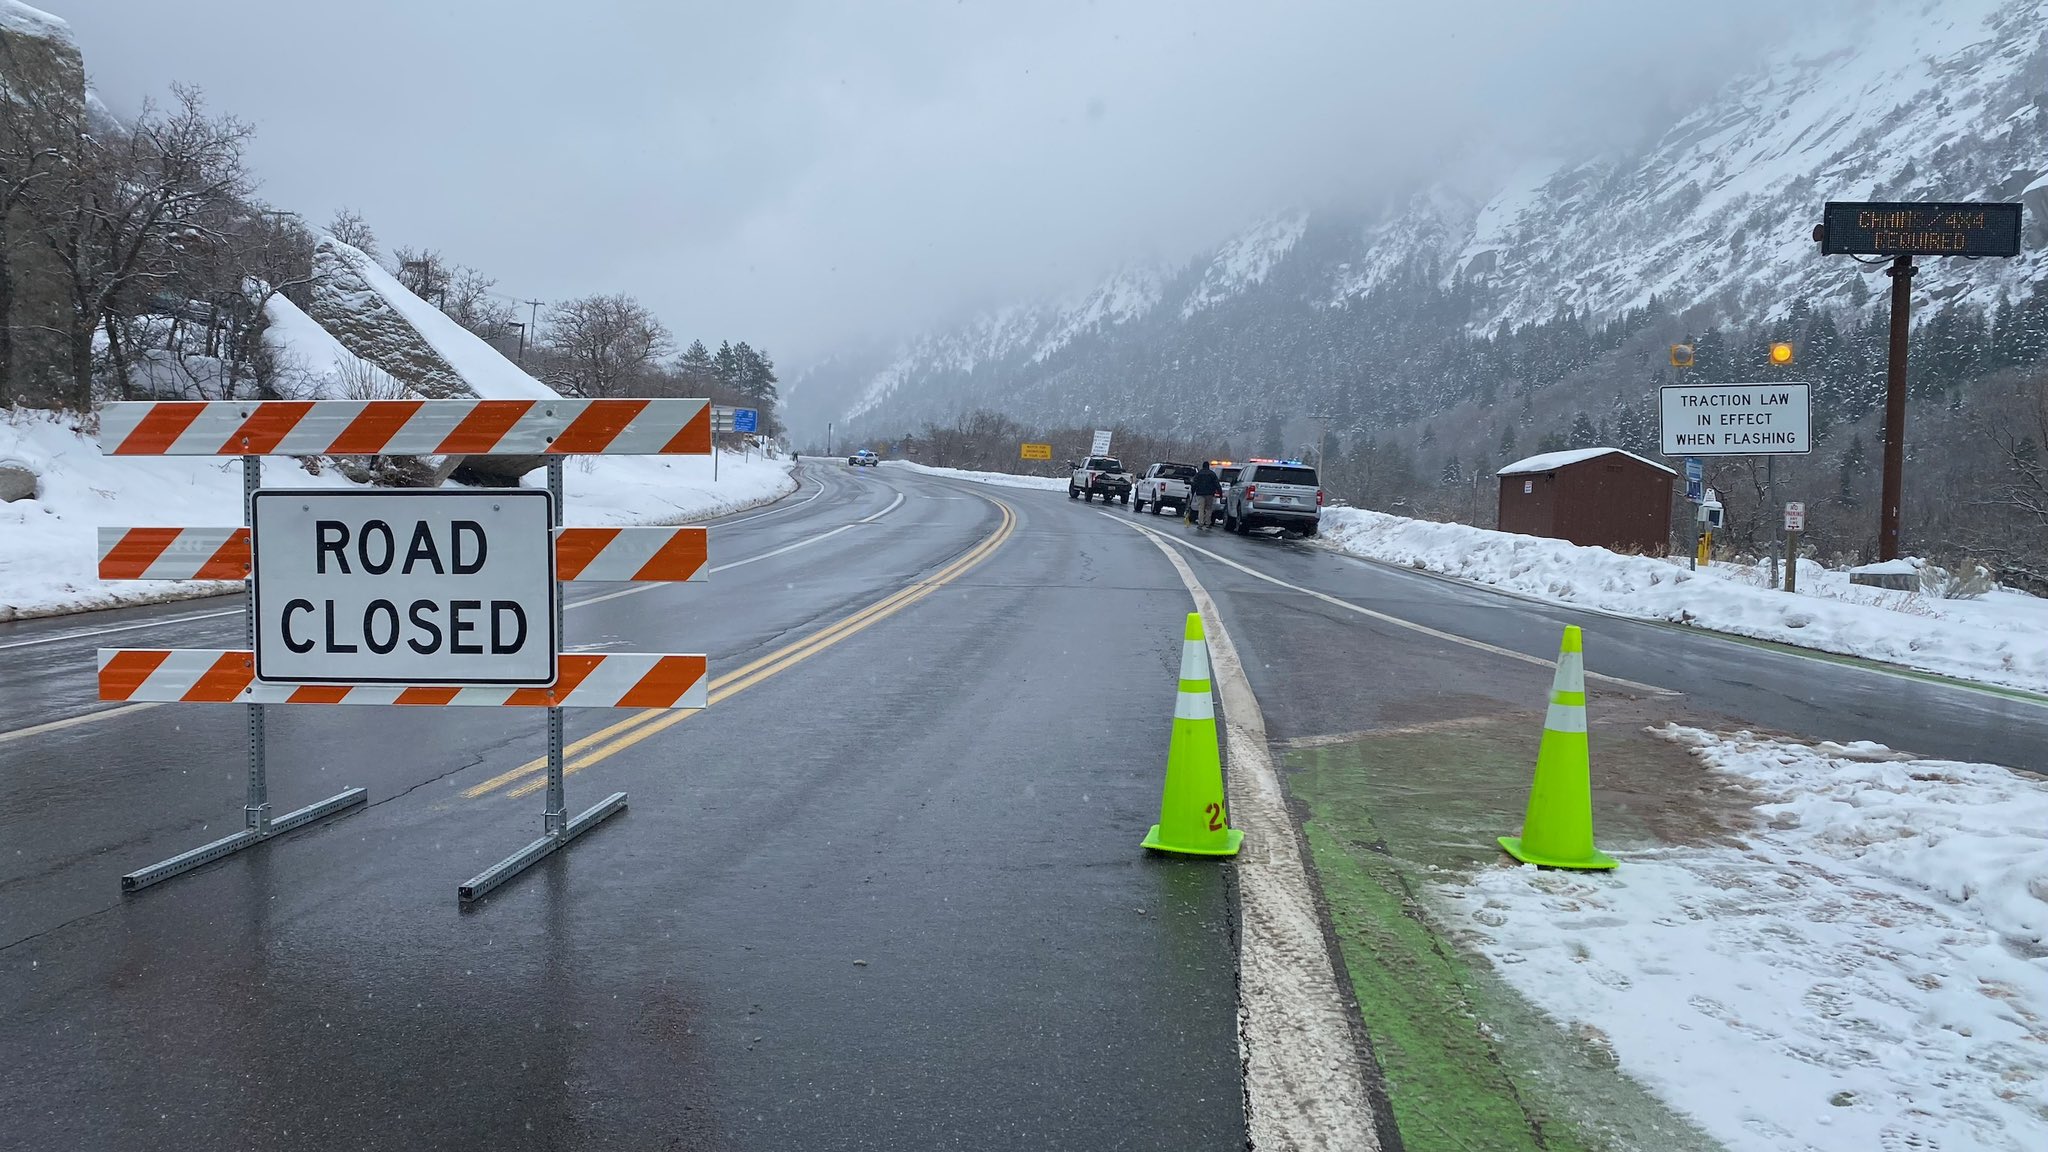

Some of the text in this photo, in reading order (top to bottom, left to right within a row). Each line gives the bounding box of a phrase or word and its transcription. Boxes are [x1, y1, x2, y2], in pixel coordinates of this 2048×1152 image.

[1874, 232, 1966, 249] REQUIRED
[1680, 393, 1789, 407] TRACTION LAW
[1697, 413, 1773, 426] IN EFFECT
[1676, 432, 1796, 446] WHEN FLASHING
[315, 520, 488, 576] ROAD
[281, 598, 528, 656] CLOSED
